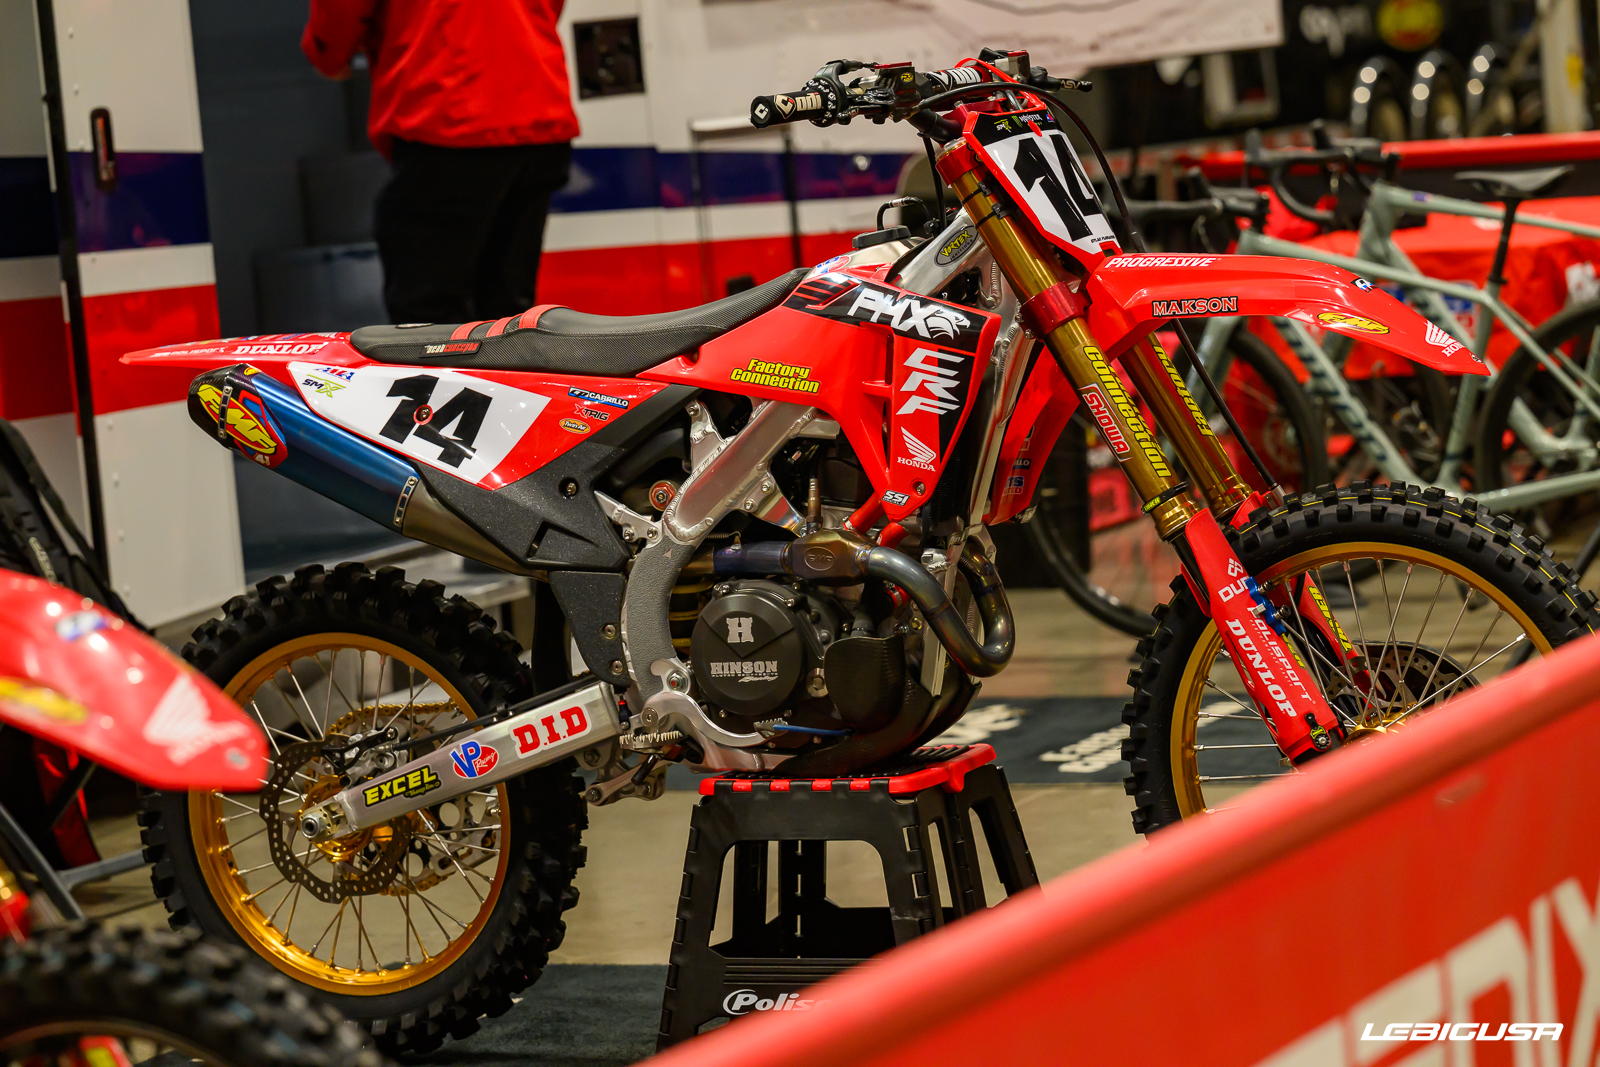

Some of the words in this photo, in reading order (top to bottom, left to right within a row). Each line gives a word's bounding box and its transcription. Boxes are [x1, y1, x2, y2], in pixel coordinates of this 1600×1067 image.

[1013, 133, 1103, 242] 14
[941, 231, 972, 257] VORTEX
[1105, 257, 1216, 268] PROGRESSIVE
[847, 288, 941, 339] PHX
[1152, 297, 1238, 316] MAKSON
[1317, 312, 1389, 333] FMF
[232, 343, 329, 354] DUNLOP
[730, 368, 820, 393] Connection
[747, 358, 811, 379] Factory
[896, 347, 965, 415] CRF
[302, 374, 346, 398] SMX
[589, 391, 629, 406] CARRILLO
[197, 385, 278, 449] FMF
[380, 374, 493, 468] 14
[574, 404, 610, 421] XTRIG
[1082, 392, 1130, 454] SHOWA
[1083, 345, 1172, 477] Connection
[897, 457, 936, 472] HONDA
[884, 490, 909, 503] SSI
[726, 616, 754, 643] H
[710, 661, 778, 674] HINSON
[1225, 618, 1297, 718] DUNLOP
[513, 706, 588, 754] D.I.D
[451, 741, 481, 778] VP
[475, 752, 497, 771] Racing
[364, 767, 437, 805] EXCEL
